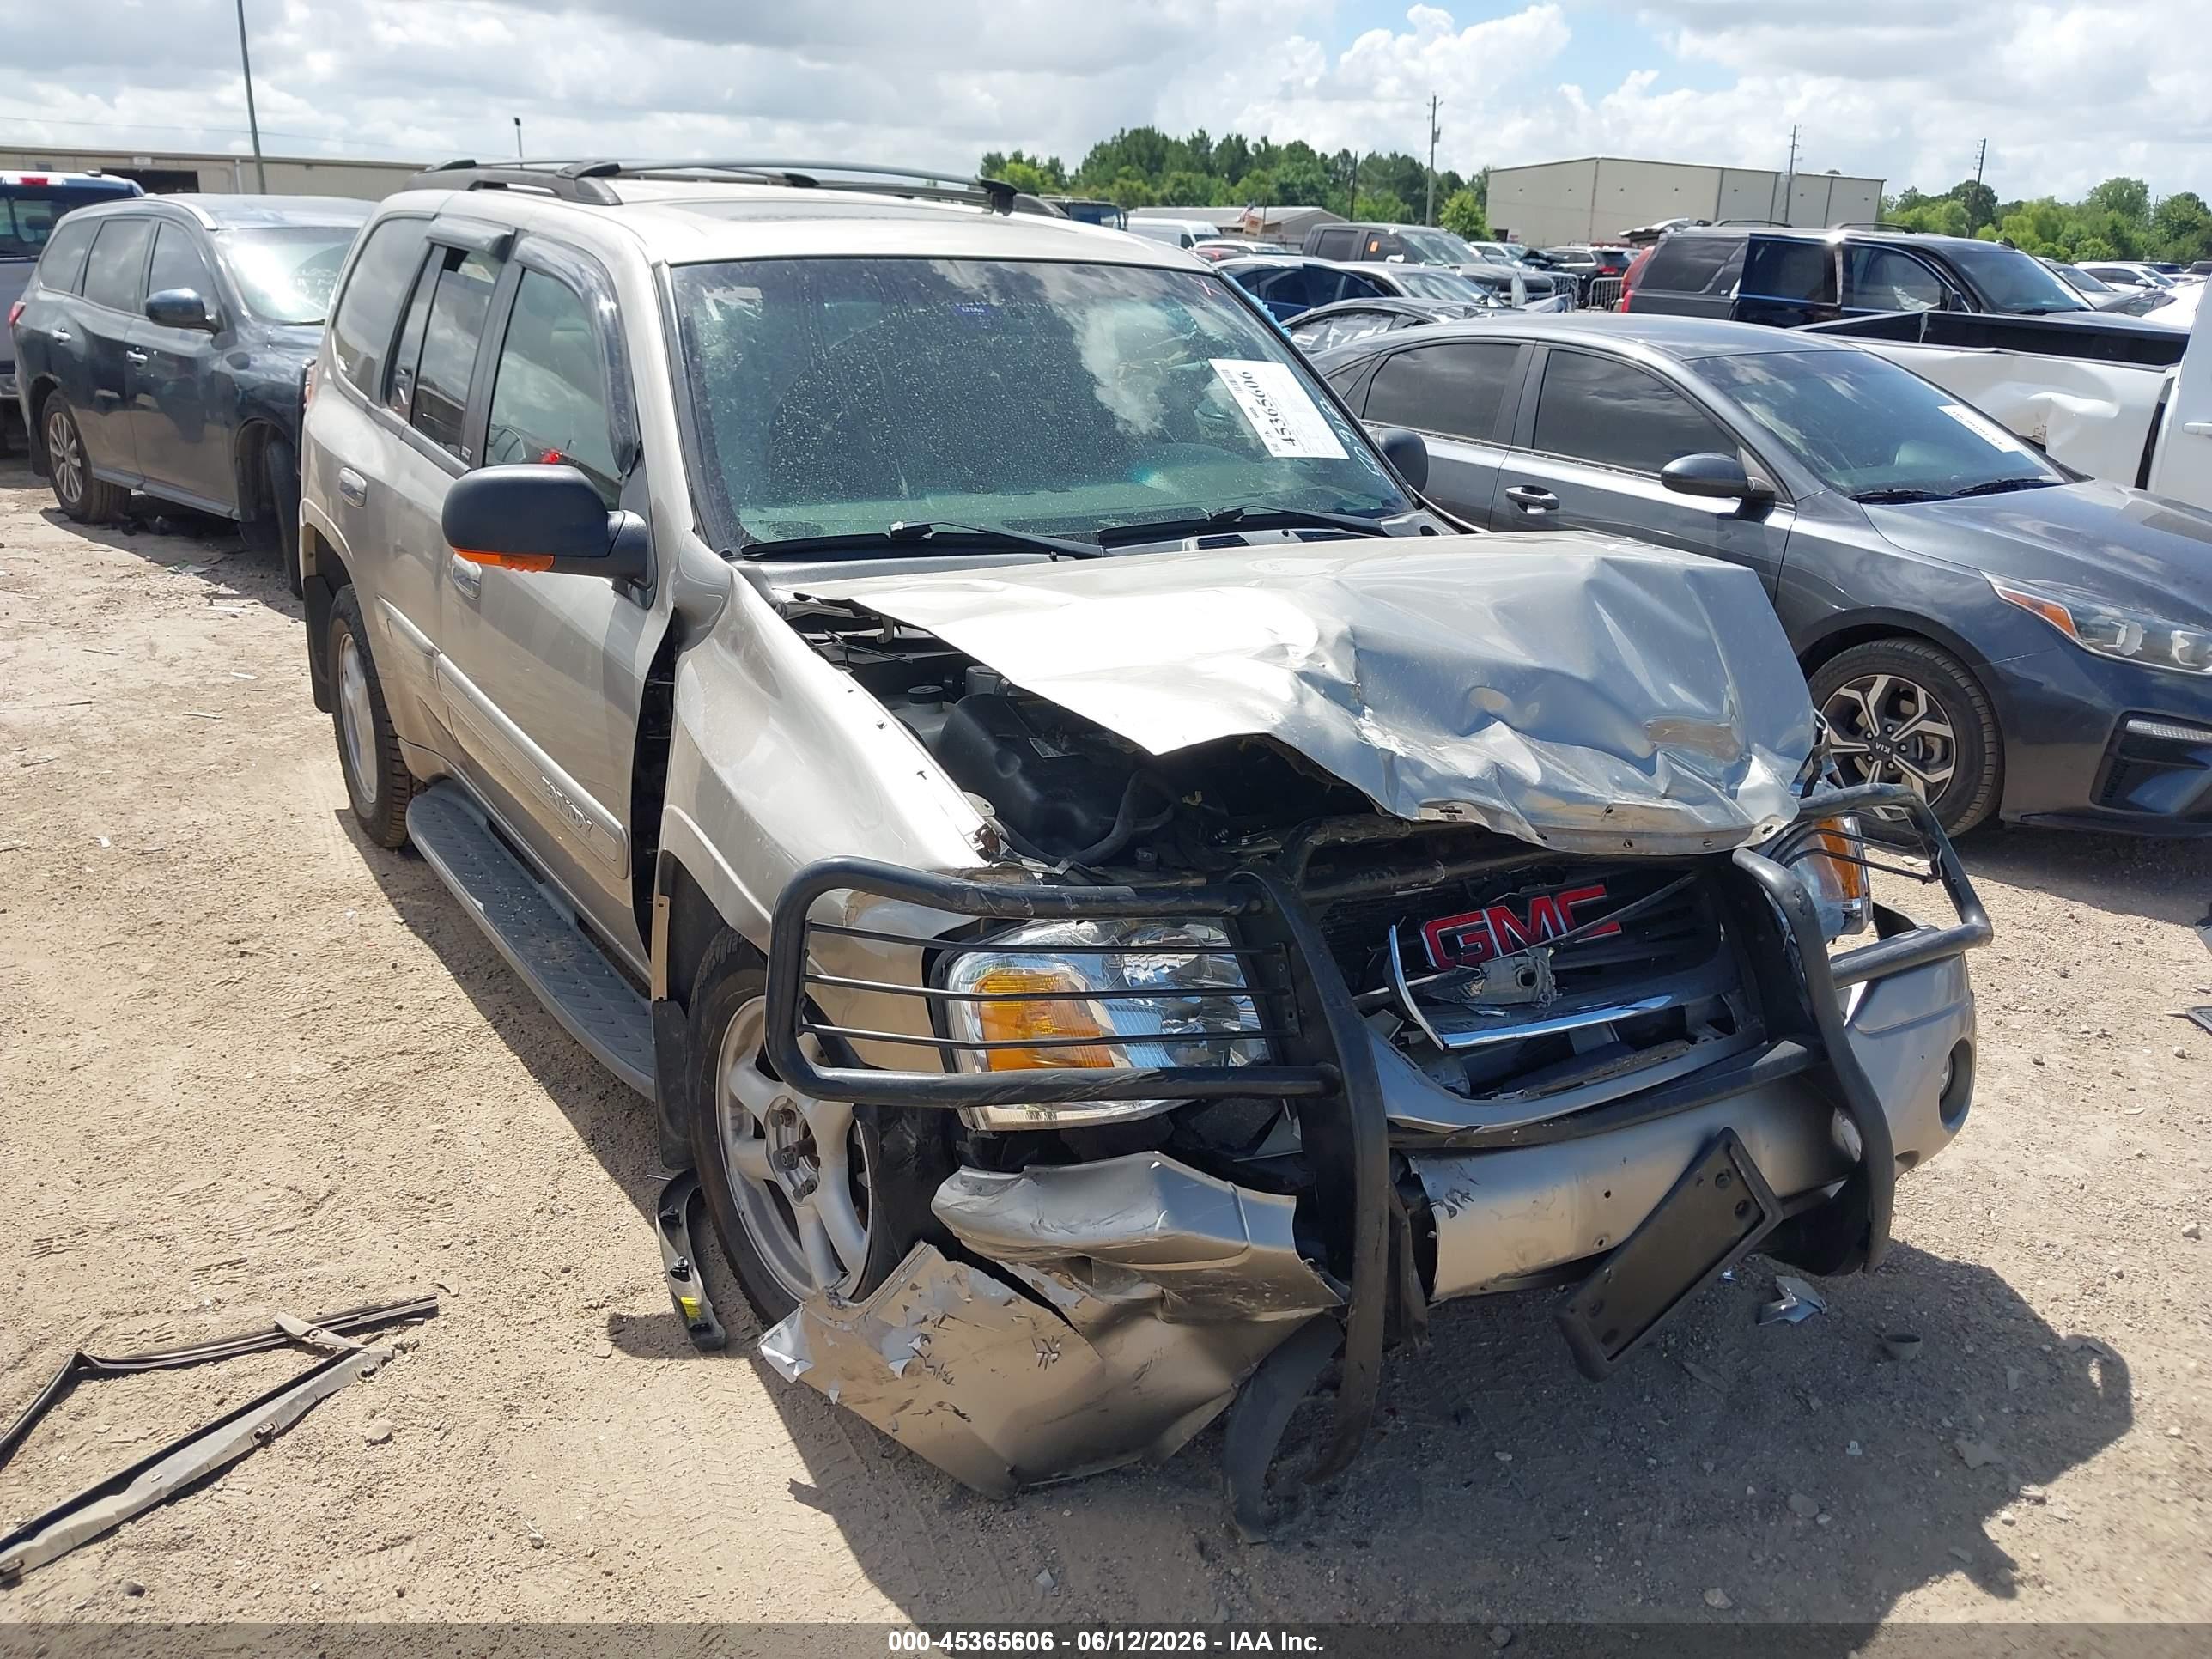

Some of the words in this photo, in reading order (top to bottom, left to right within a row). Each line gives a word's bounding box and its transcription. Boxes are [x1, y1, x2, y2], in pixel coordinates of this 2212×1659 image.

[1237, 371, 1297, 447] 45365606
[1875, 741, 1892, 755] KIA
[1419, 884, 1623, 971] GMC
